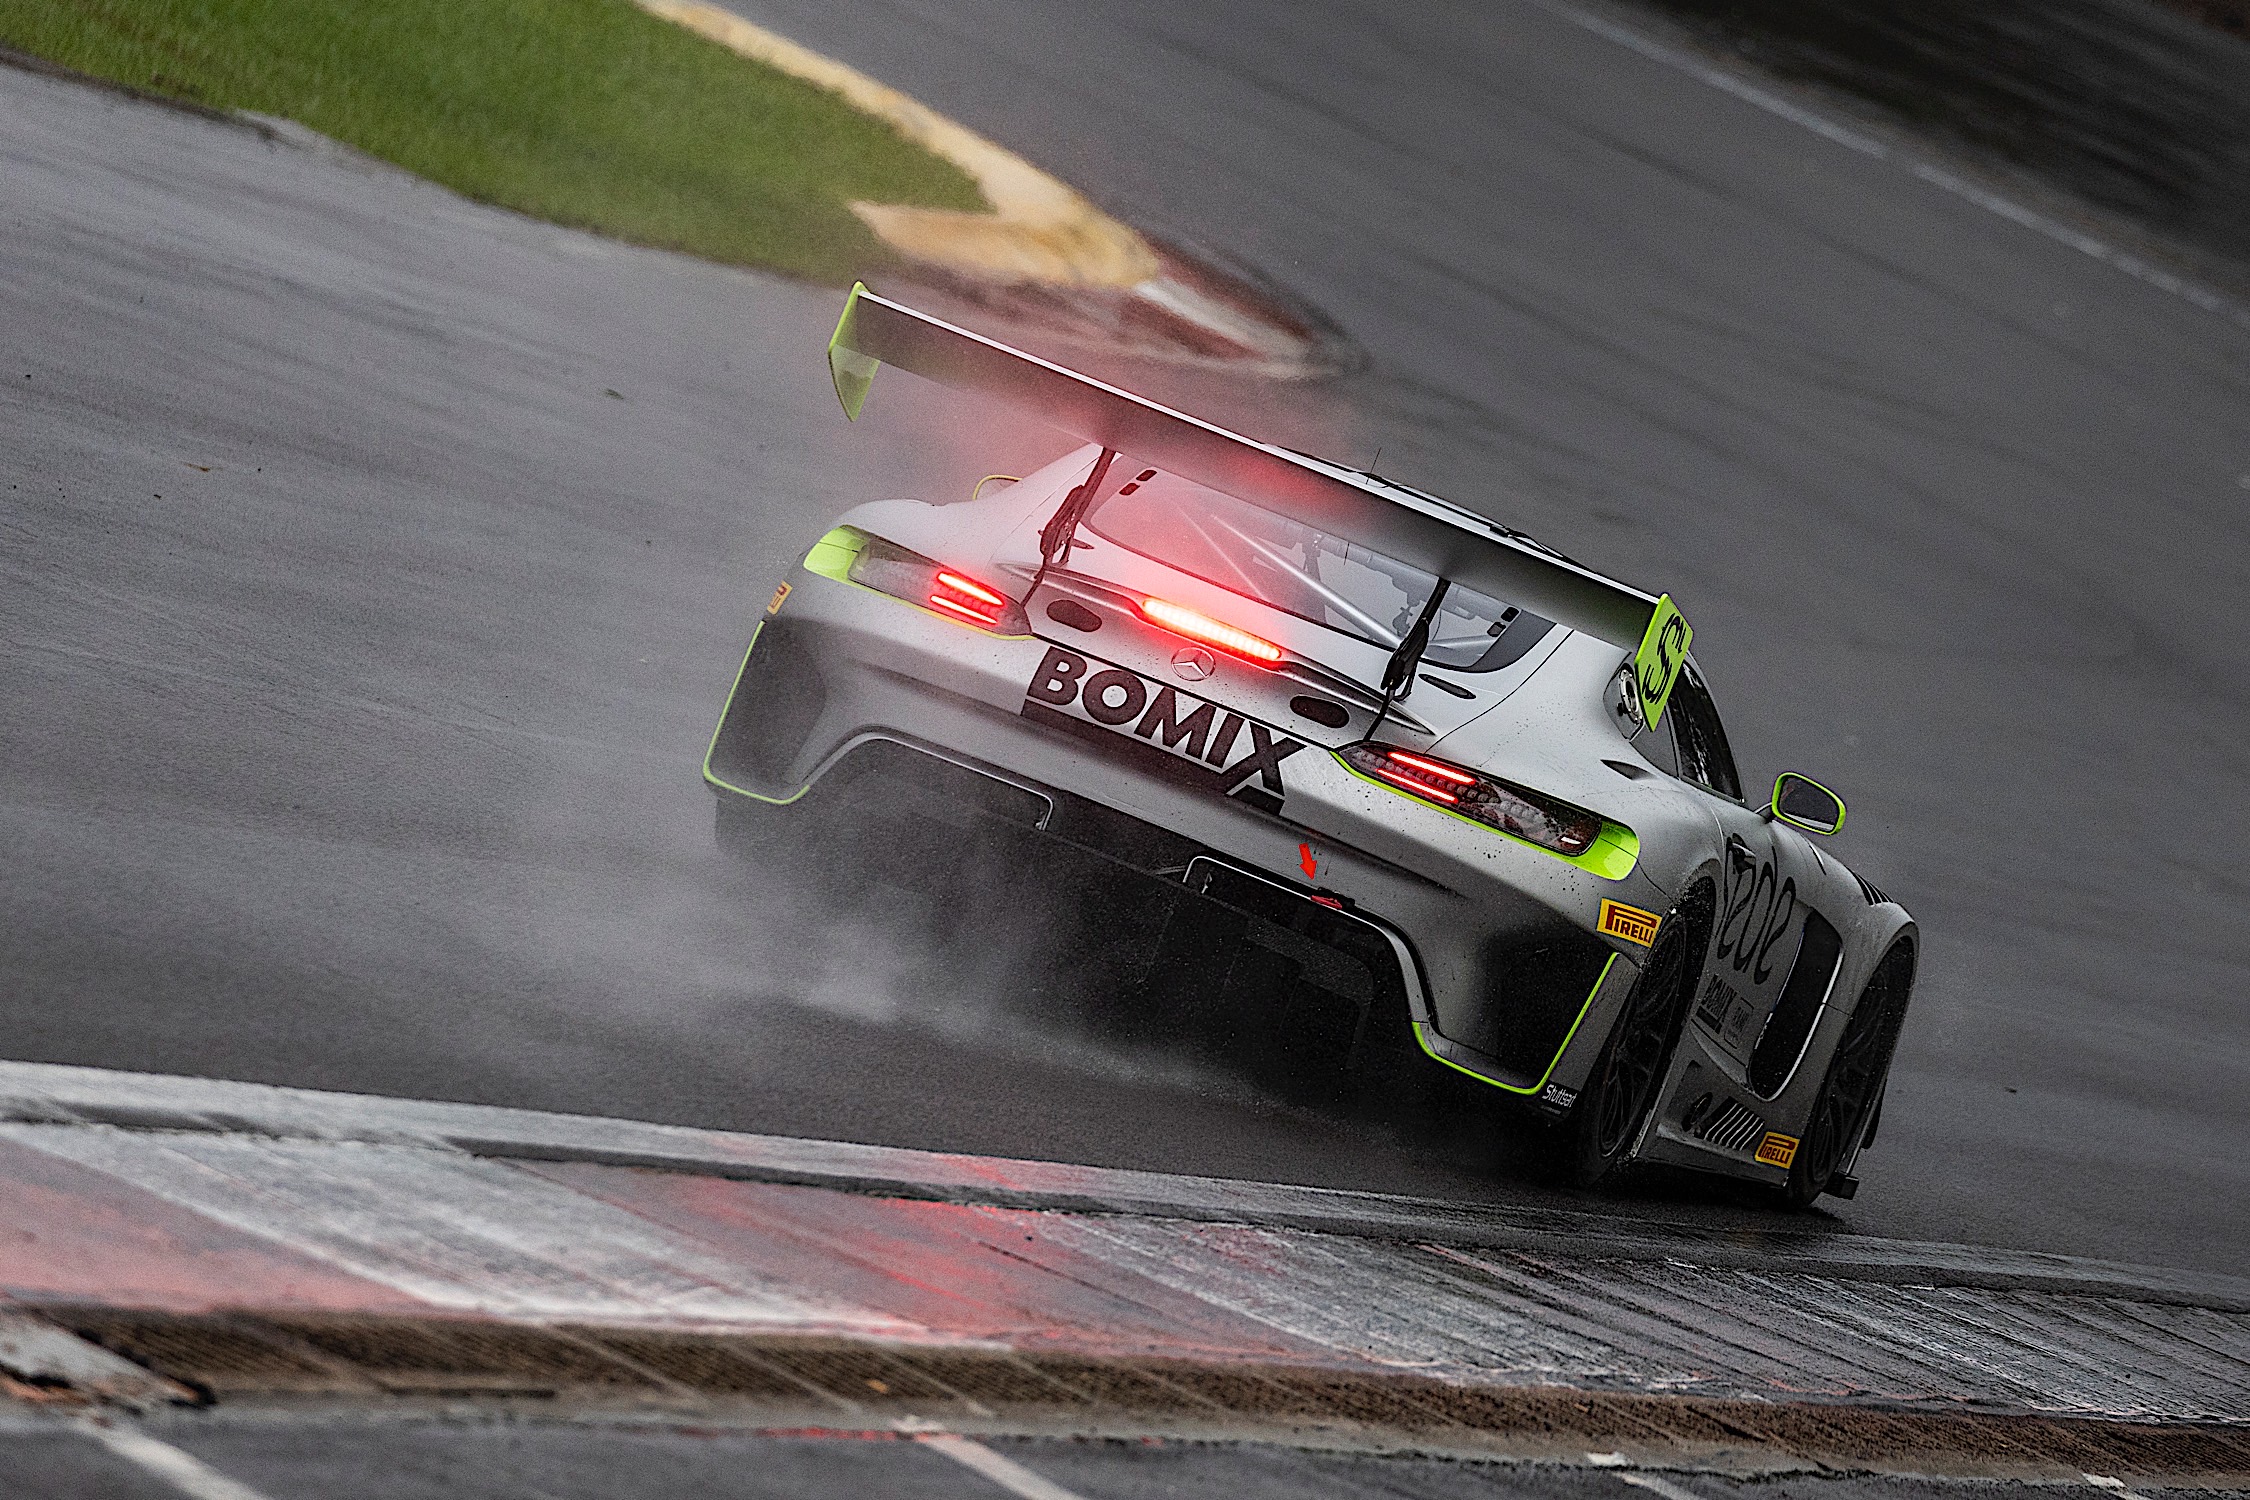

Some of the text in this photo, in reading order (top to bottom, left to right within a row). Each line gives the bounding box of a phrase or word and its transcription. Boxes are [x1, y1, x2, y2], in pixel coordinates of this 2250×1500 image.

[1026, 646, 1307, 797] BOMIX
[1605, 904, 1658, 944] PIRELLI
[1758, 1136, 1796, 1164] PIRELLI
